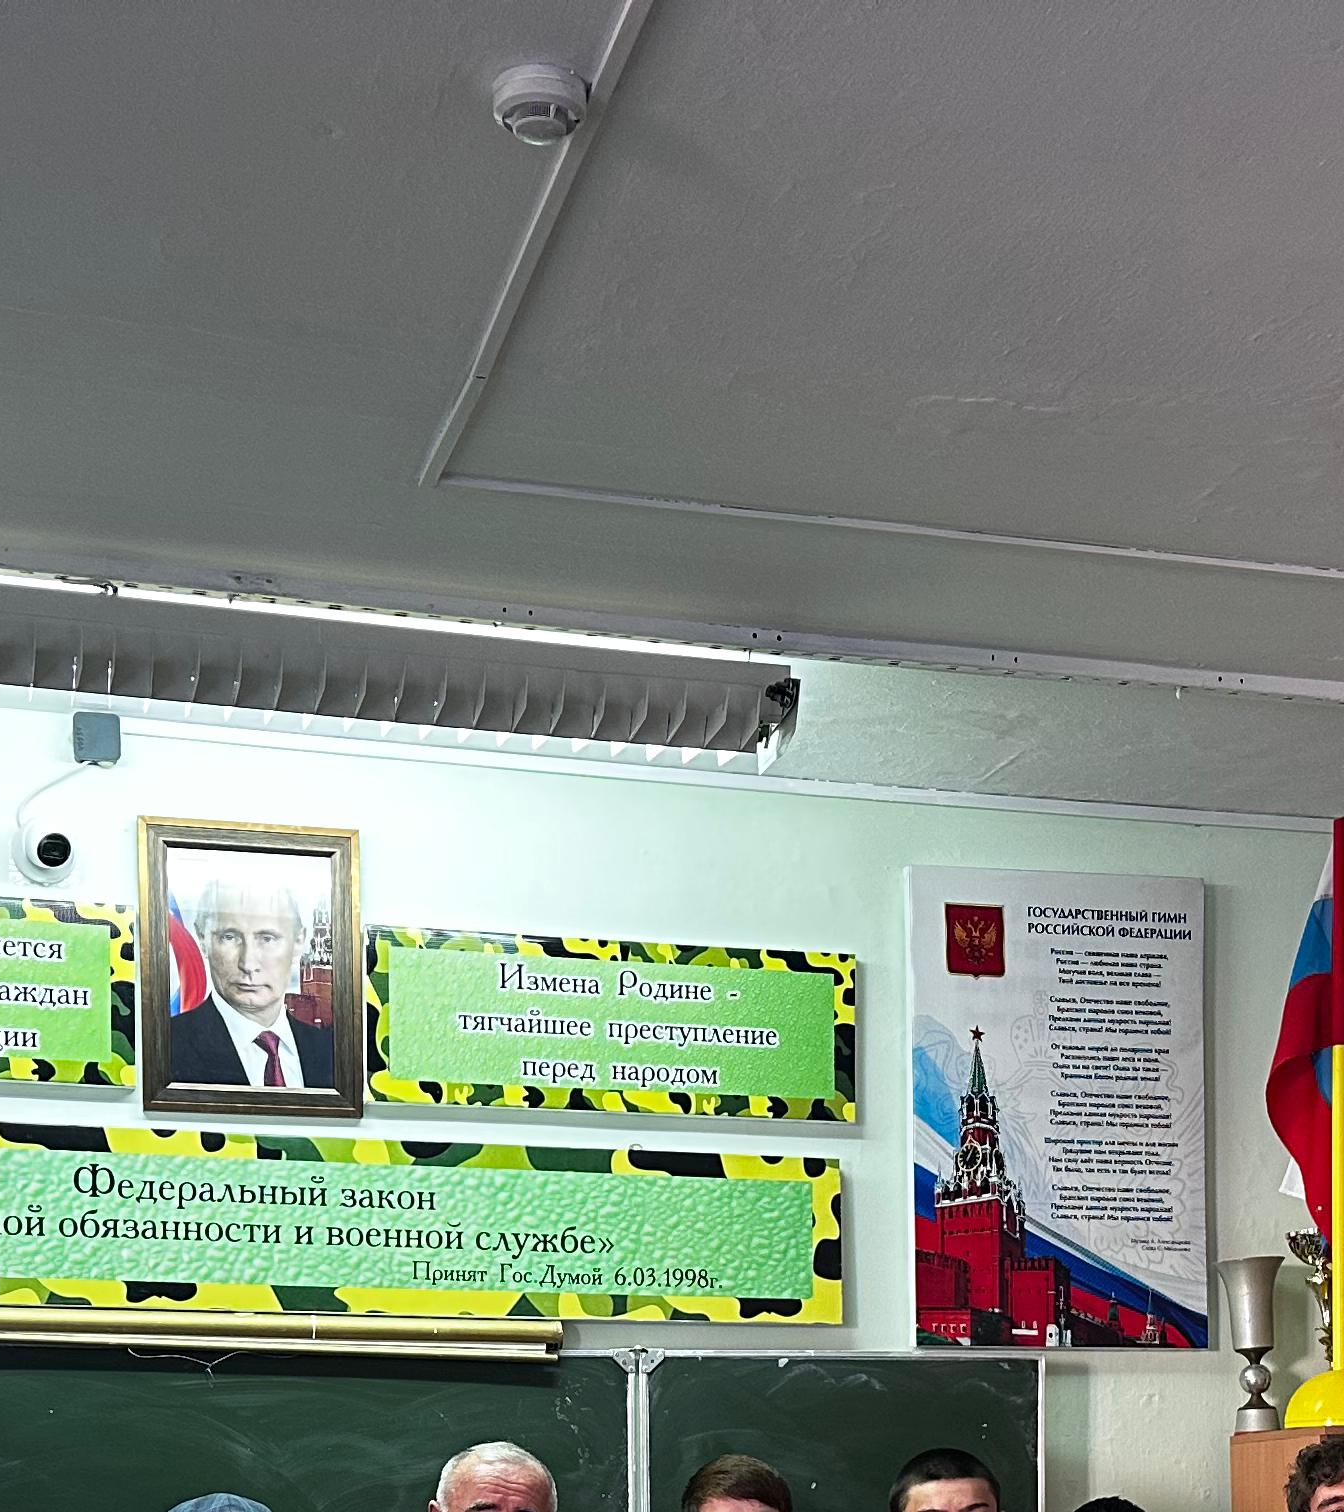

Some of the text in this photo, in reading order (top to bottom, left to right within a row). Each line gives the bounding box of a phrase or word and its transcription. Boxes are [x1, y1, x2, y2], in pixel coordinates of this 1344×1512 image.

[1027, 906, 1187, 924] ГОСУДАРСТВЕННЫЙ ГИМН
[1027, 923, 1192, 940] РОССИЙСКОЙ ФЕДЕРАЦИИ
[500, 963, 600, 994] Измена
[618, 971, 711, 1001] Родине
[459, 1010, 778, 1047] тягчайшее преступление
[523, 1061, 717, 1087] перед народом
[74, 1164, 436, 1210] Федеральный закон
[59, 1209, 281, 1243] обязанности
[294, 1226, 314, 1245] и
[326, 1222, 464, 1249] военной
[476, 1226, 614, 1259] службе»
[412, 1261, 726, 1291] Принят Гос.Думой 6.03.1998г.
